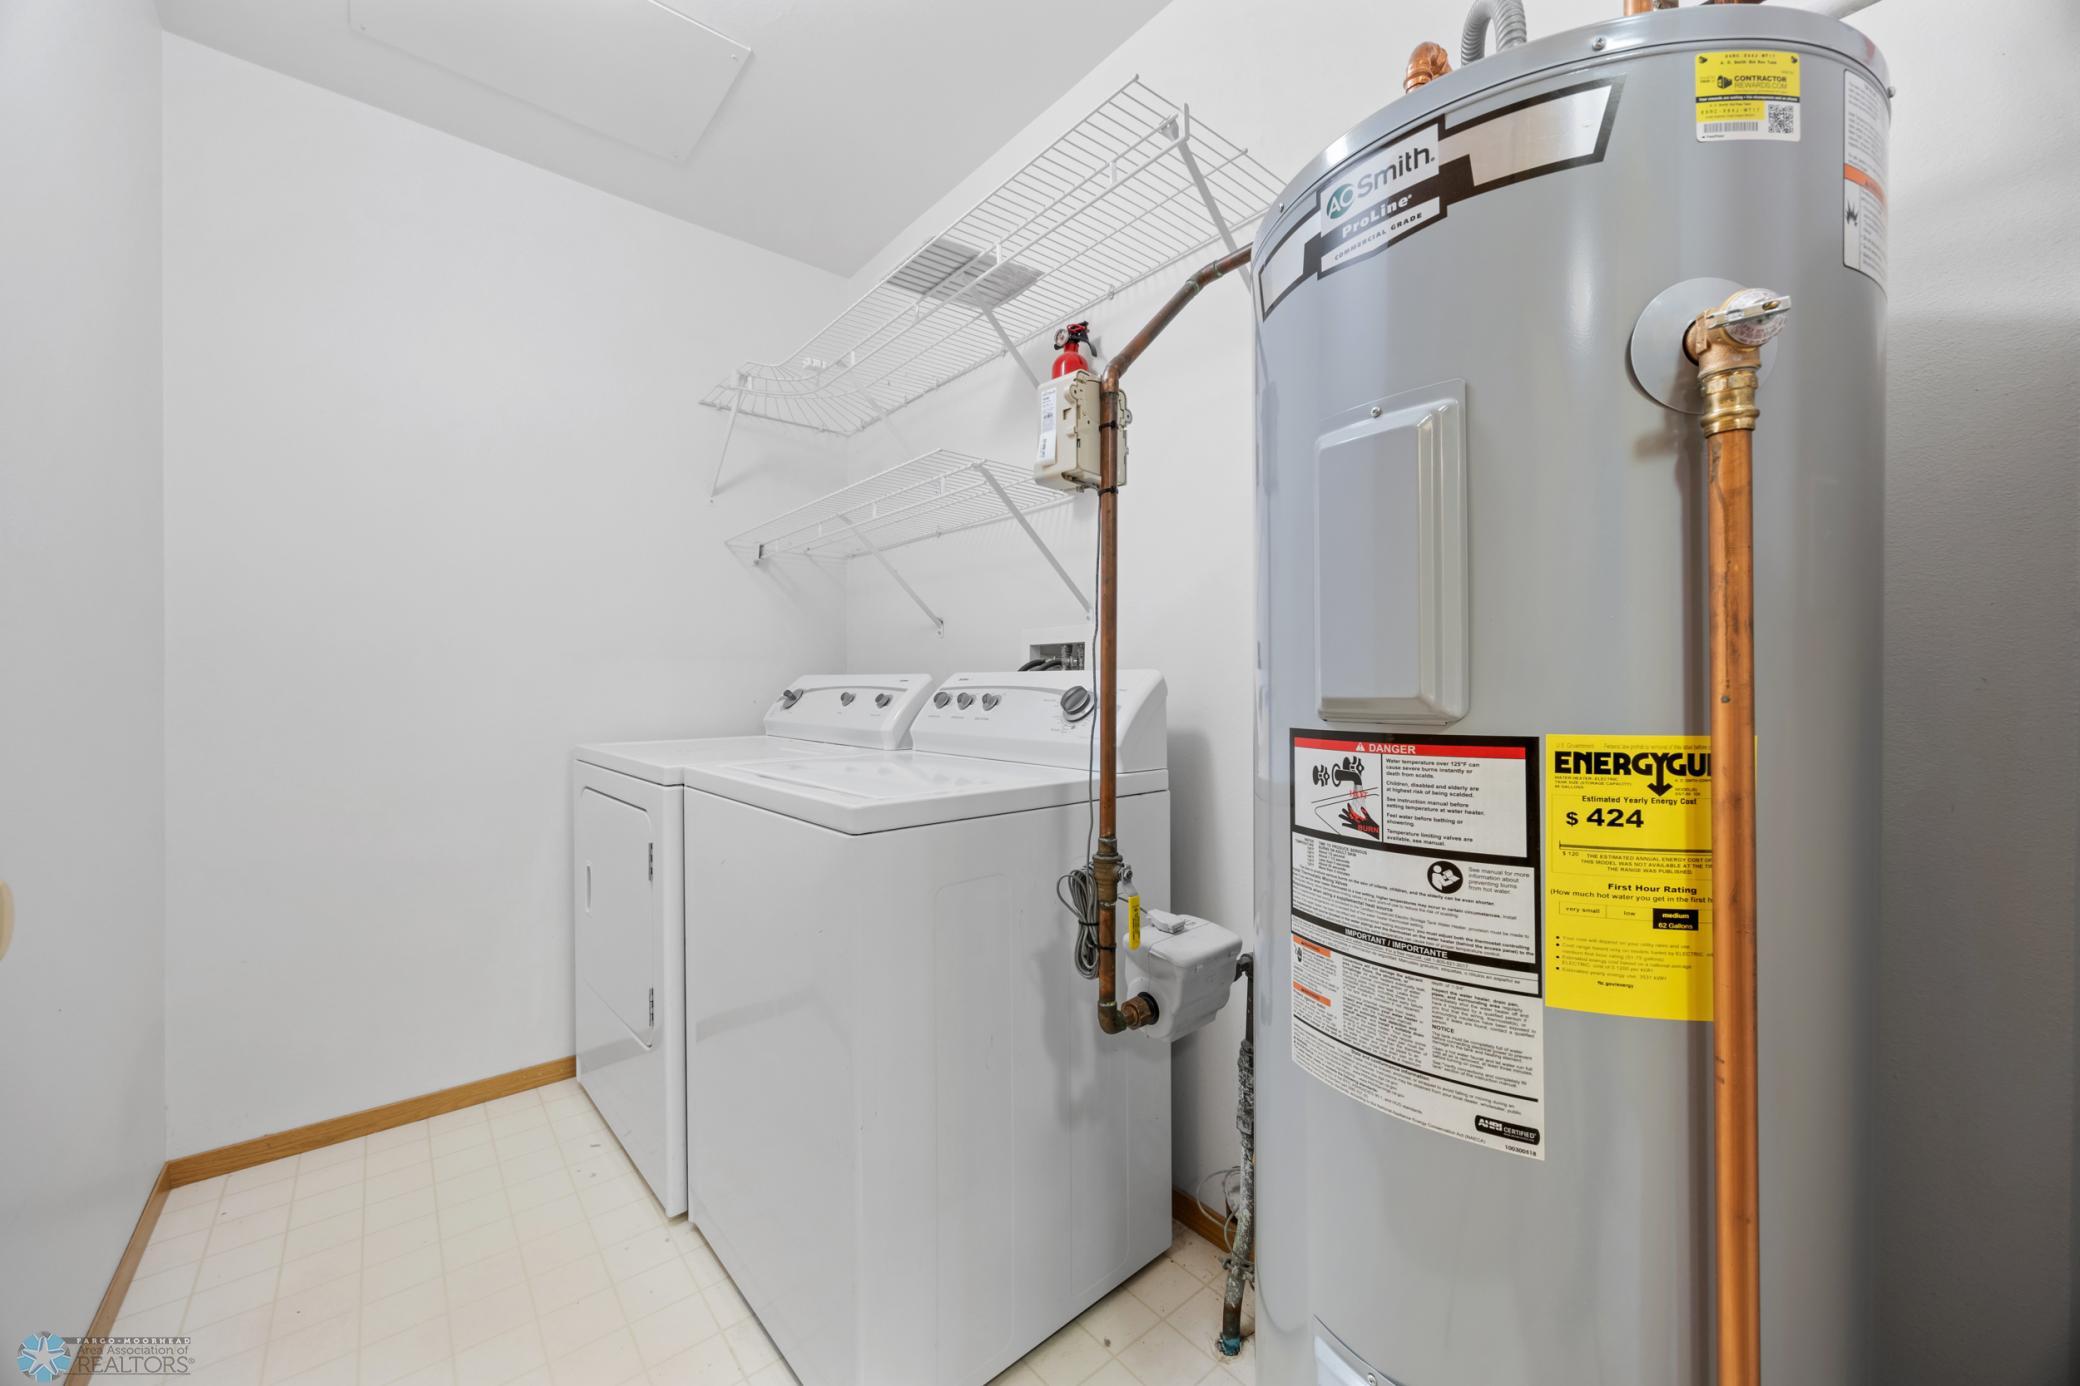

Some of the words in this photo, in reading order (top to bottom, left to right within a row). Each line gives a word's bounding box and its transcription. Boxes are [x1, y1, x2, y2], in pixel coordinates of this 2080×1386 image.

[1358, 147, 1430, 199] Smith
[1334, 229, 1386, 260] COMMERCIAL
[1391, 212, 1422, 231] GRADE
[1369, 744, 1415, 754] DANGER
[1582, 796, 1620, 804] Estimated
[1624, 796, 1648, 805] Yearly
[1651, 798, 1678, 806] Energy
[1566, 811, 1578, 826] $
[1587, 808, 1644, 828] 424
[1357, 824, 1378, 833] BURN
[1469, 880, 1499, 888] preventing
[1608, 883, 1631, 891] First
[1664, 886, 1697, 895] Rating
[1345, 928, 1386, 946] IMPORTANT
[1392, 940, 1448, 959] IMPORTANTE
[1432, 1024, 1454, 1033] NOTICE
